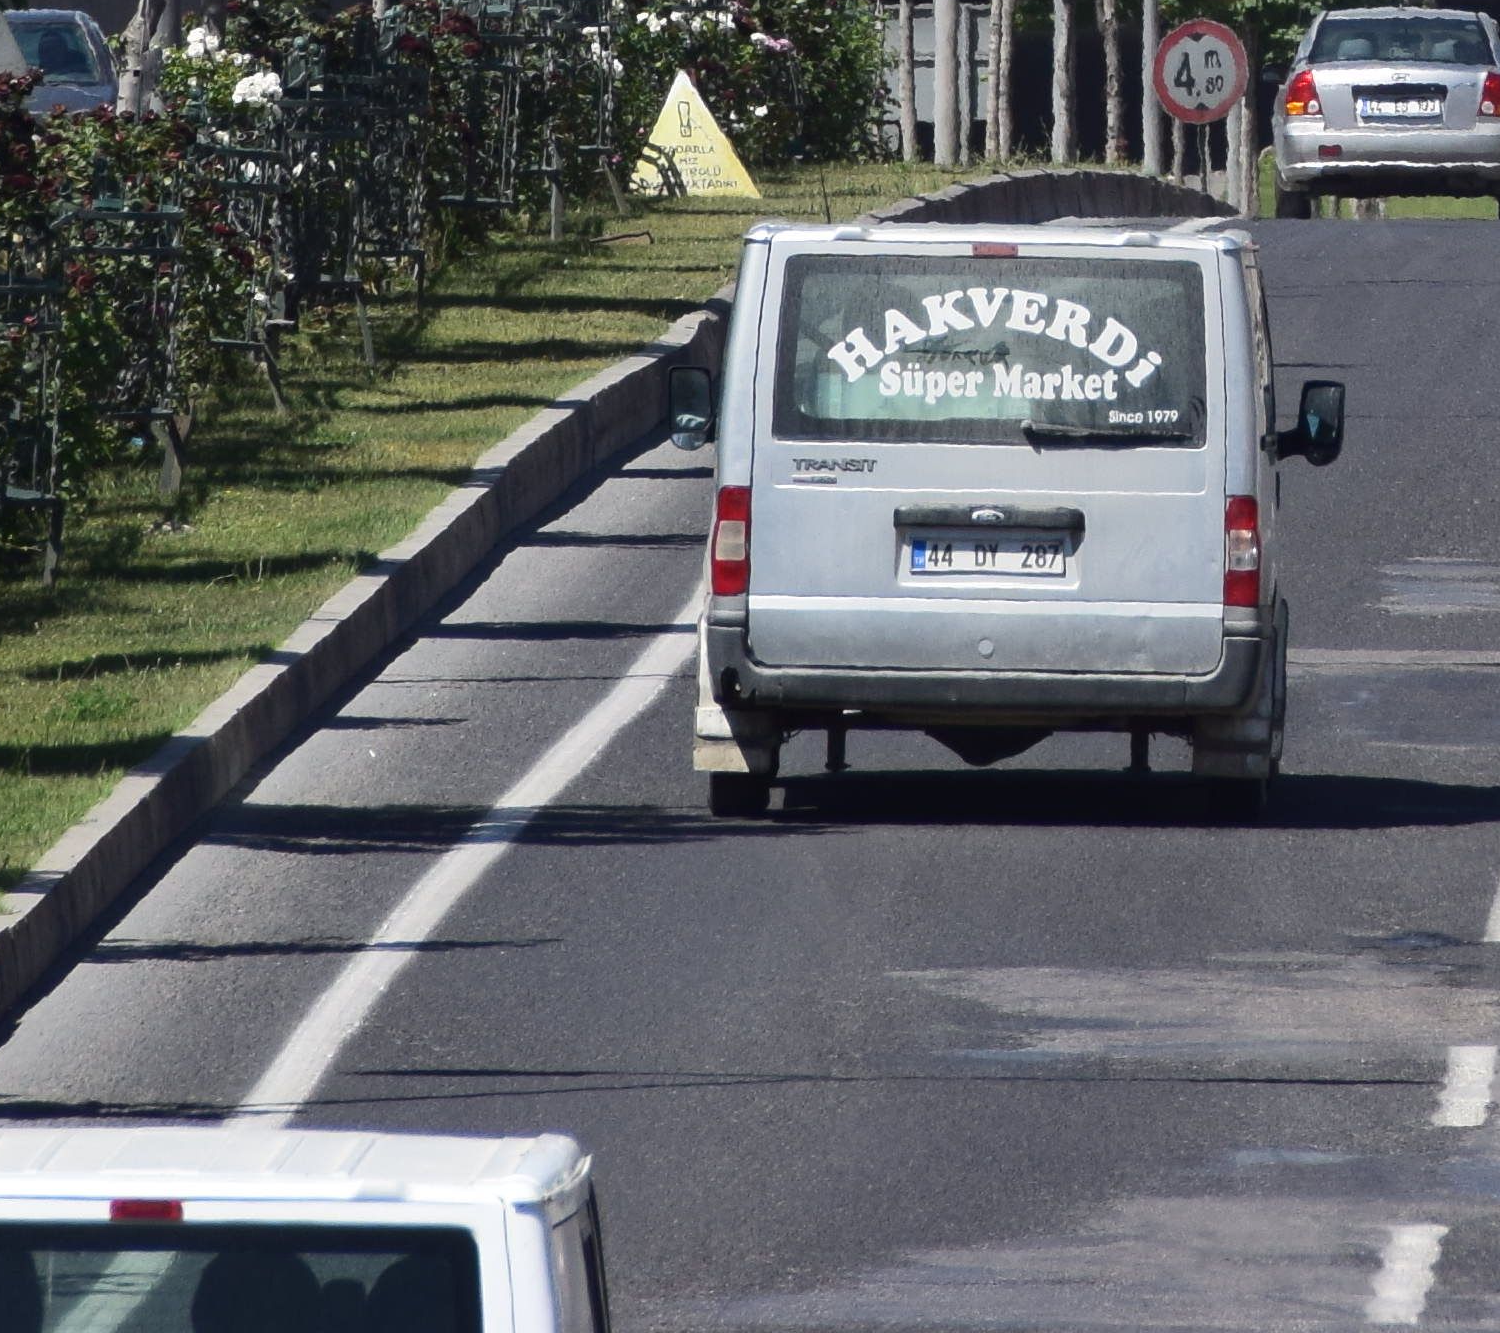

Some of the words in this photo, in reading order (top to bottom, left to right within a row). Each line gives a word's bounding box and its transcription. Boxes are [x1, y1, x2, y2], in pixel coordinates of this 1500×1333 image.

[878, 361, 985, 405] Süper
[992, 362, 1119, 401] Market
[1108, 409, 1145, 424] Since
[1146, 408, 1179, 423] 1979
[793, 458, 878, 473] TRANSIT
[927, 543, 954, 568] 44
[974, 543, 999, 568] DY
[1020, 545, 1061, 570] 287
